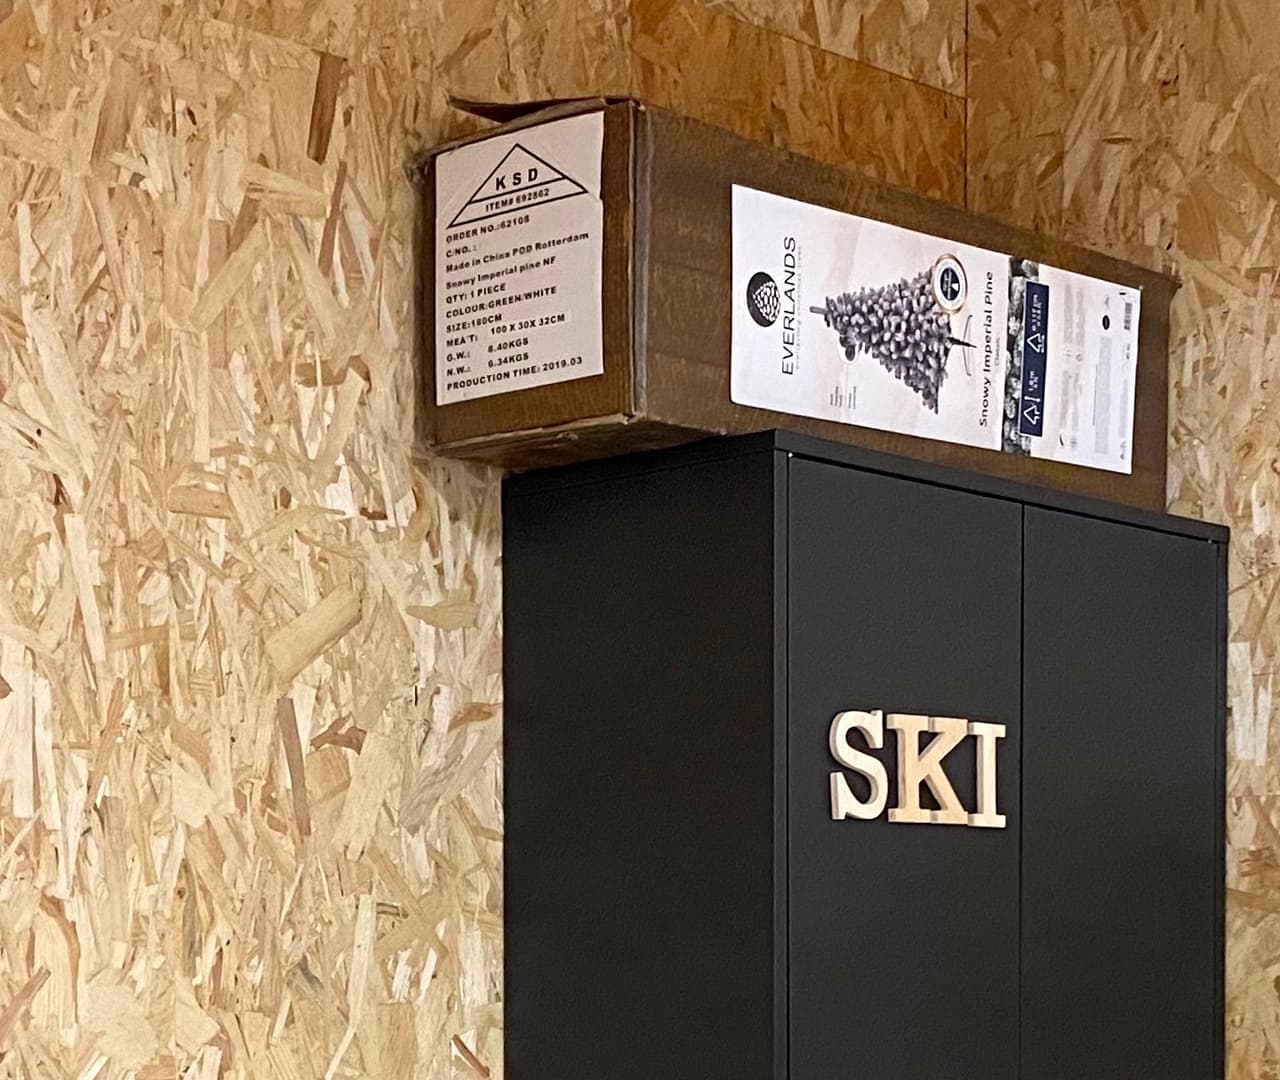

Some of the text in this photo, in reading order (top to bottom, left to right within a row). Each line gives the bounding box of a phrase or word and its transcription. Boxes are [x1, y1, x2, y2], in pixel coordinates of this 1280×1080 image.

[446, 226, 478, 244] ORDER
[446, 232, 589, 273] Made in China POD Rotterdam
[446, 255, 557, 290] Snowy Imperial pine NF
[477, 282, 507, 298] PIECE
[781, 236, 796, 375] EVERLANDS
[490, 324, 508, 335] 100
[509, 322, 516, 332] X
[538, 313, 566, 327] 32CM
[978, 271, 994, 428] Snowy Imperial Pine
[446, 370, 511, 391] PRODUCTION
[542, 356, 583, 372] 2019.03
[828, 709, 1007, 829] SKI
